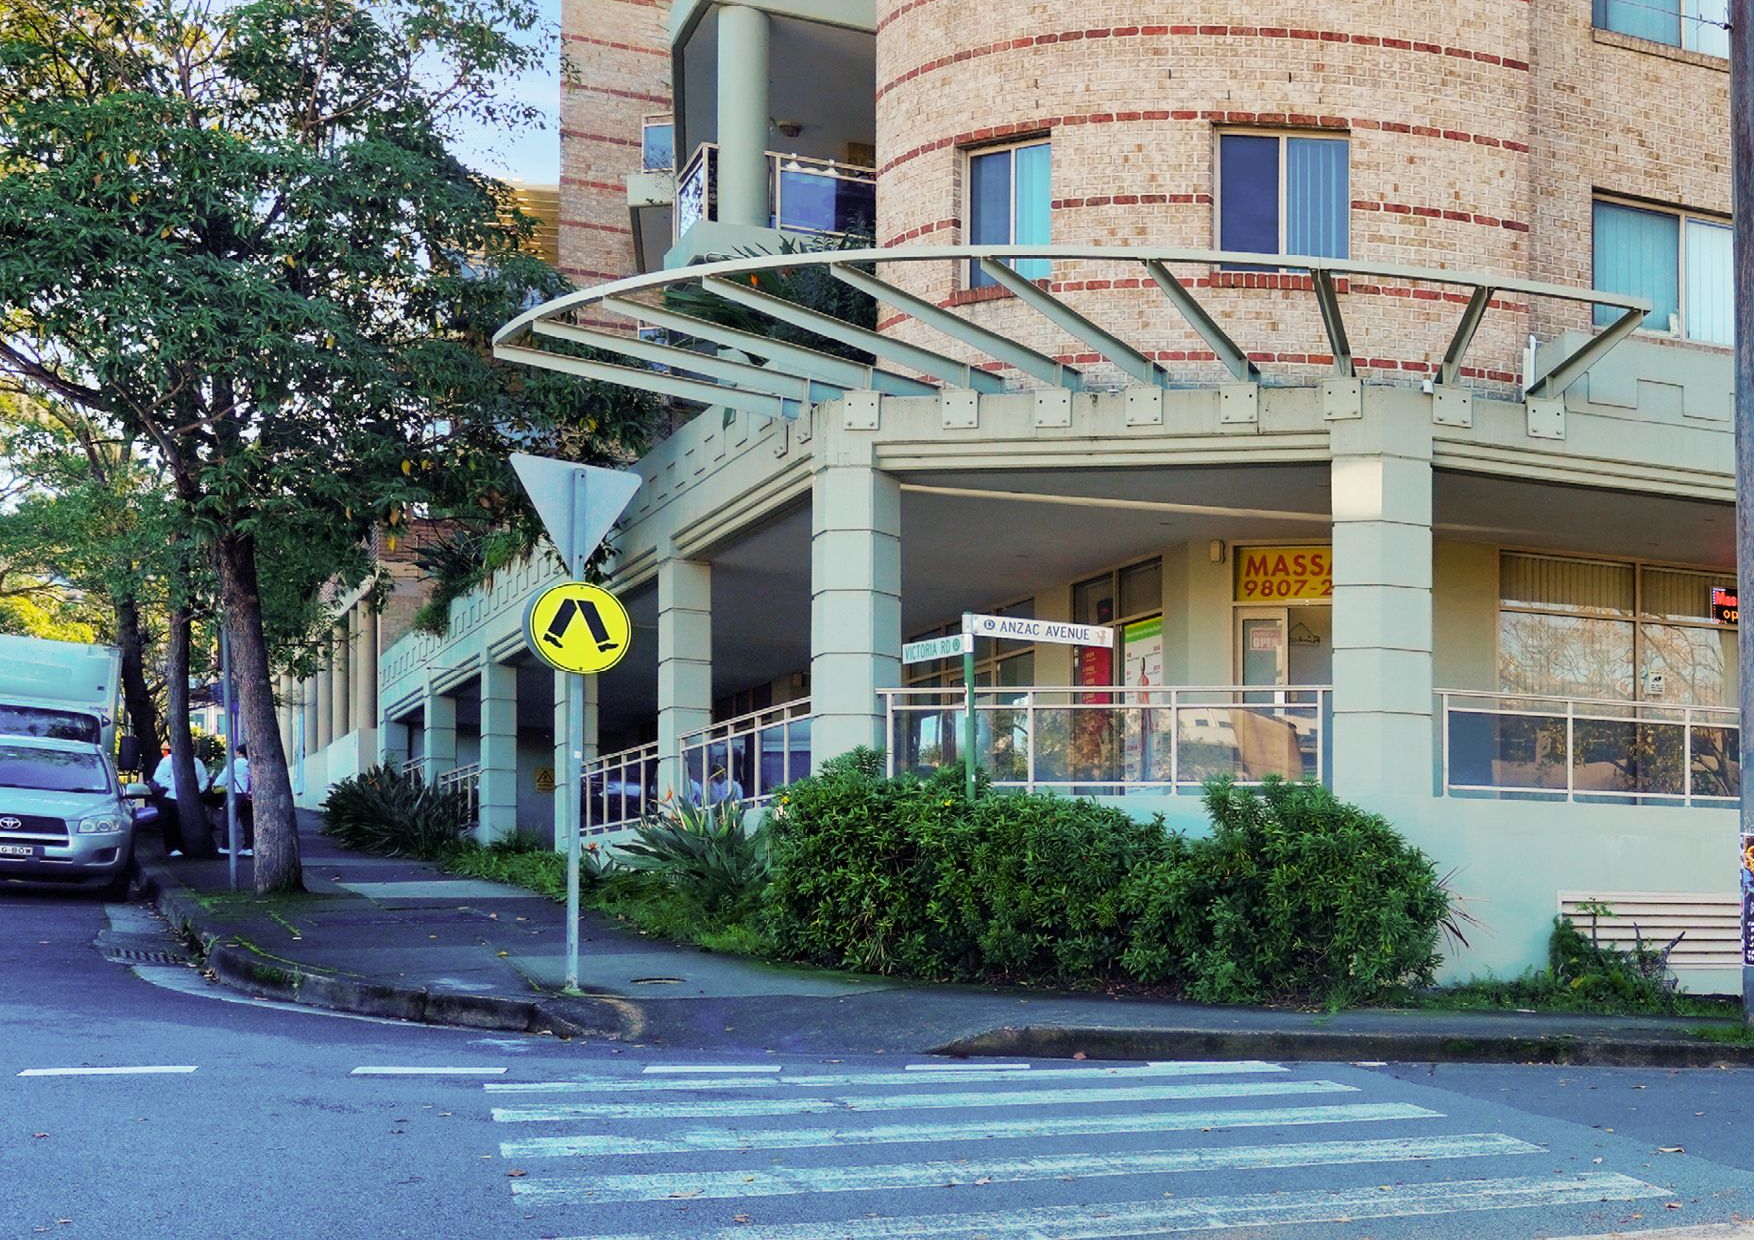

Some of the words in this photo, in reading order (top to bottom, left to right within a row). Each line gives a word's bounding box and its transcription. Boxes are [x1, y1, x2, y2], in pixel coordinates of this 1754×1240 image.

[1000, 621, 1040, 636] ANZAC
[1045, 625, 1090, 641] AVENUE
[905, 642, 937, 660] VICTORIA
[941, 639, 951, 654] RD
